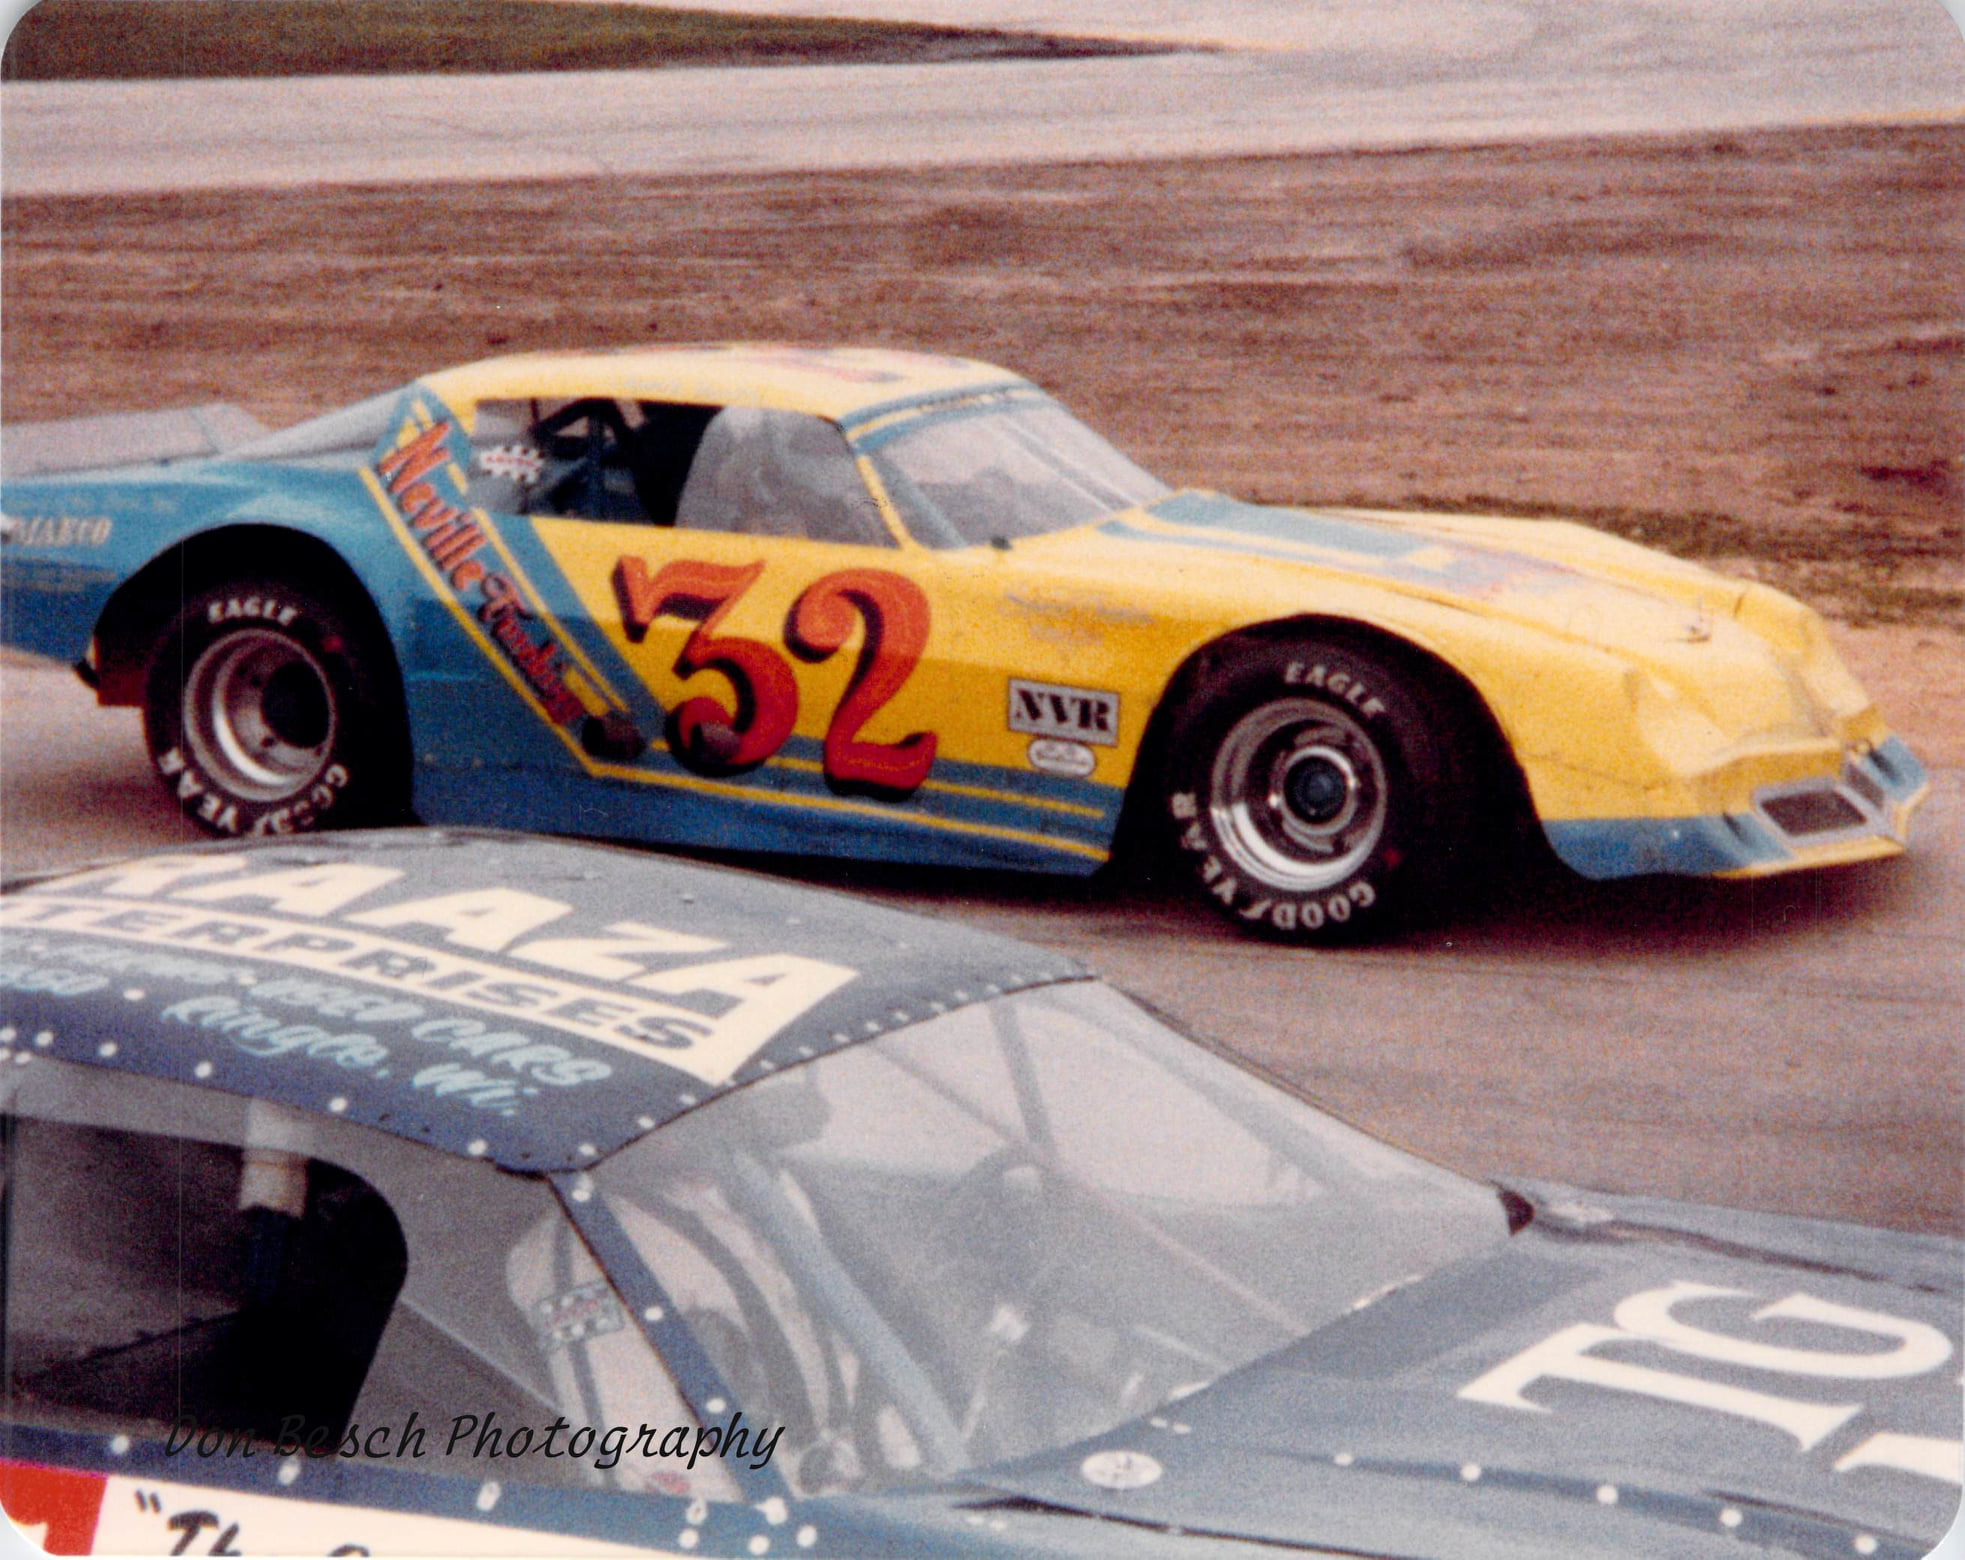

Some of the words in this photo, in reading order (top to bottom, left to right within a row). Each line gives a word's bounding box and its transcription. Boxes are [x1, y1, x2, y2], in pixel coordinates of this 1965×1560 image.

[378, 421, 487, 591] Neville
[207, 597, 299, 626] EAGLE
[610, 555, 938, 802] 32
[1284, 661, 1386, 717] EAGLE
[0, 899, 718, 1053] TERPRISES
[411, 1017, 613, 1087] CARS
